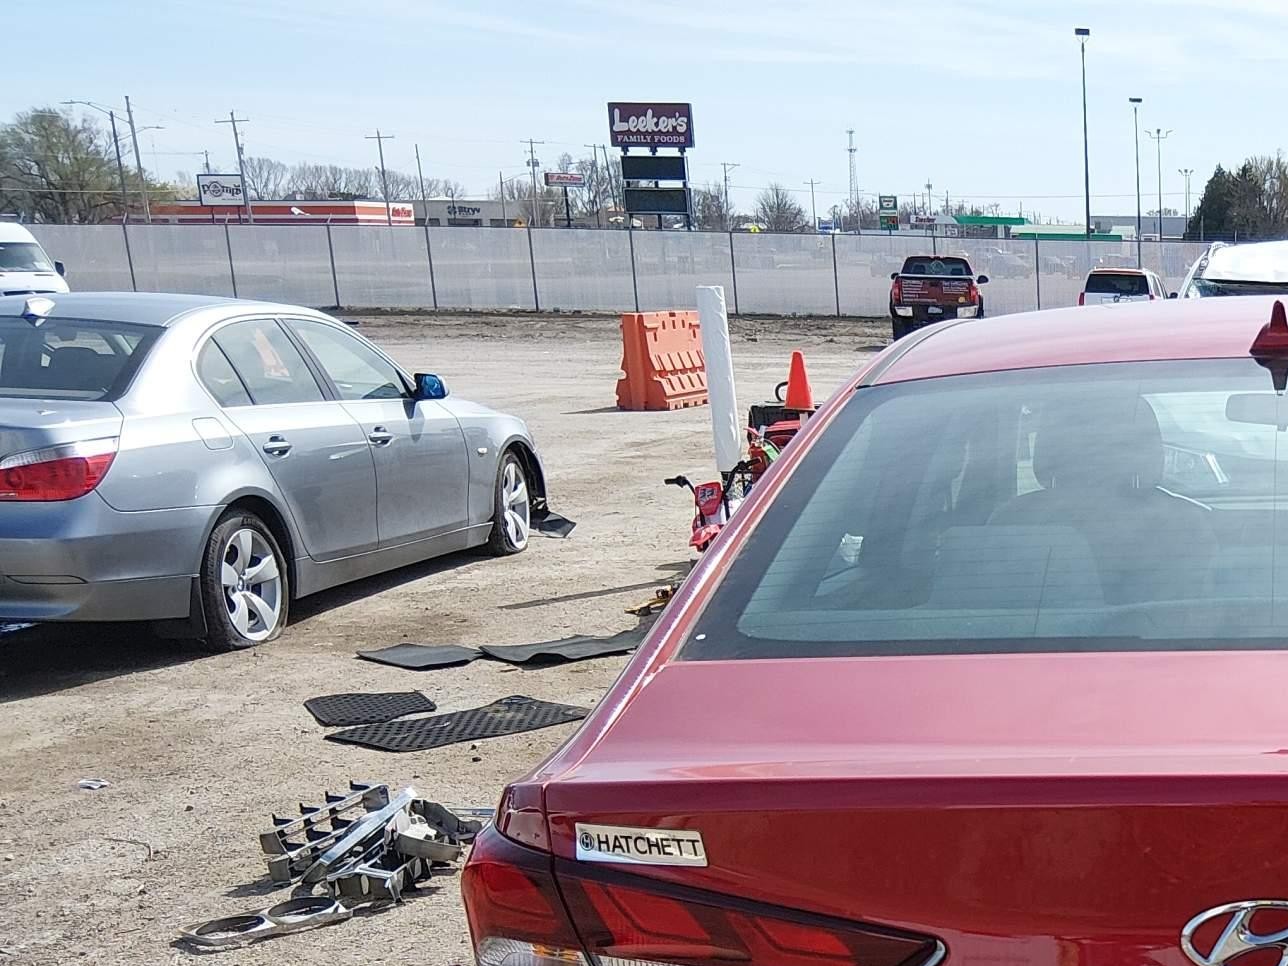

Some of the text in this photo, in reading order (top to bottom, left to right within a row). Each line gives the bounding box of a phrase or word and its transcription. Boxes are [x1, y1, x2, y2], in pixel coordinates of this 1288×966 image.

[613, 108, 687, 133] Leeker's
[617, 135, 685, 143] FAMILY FOODS
[596, 833, 700, 857] HATCHETT
